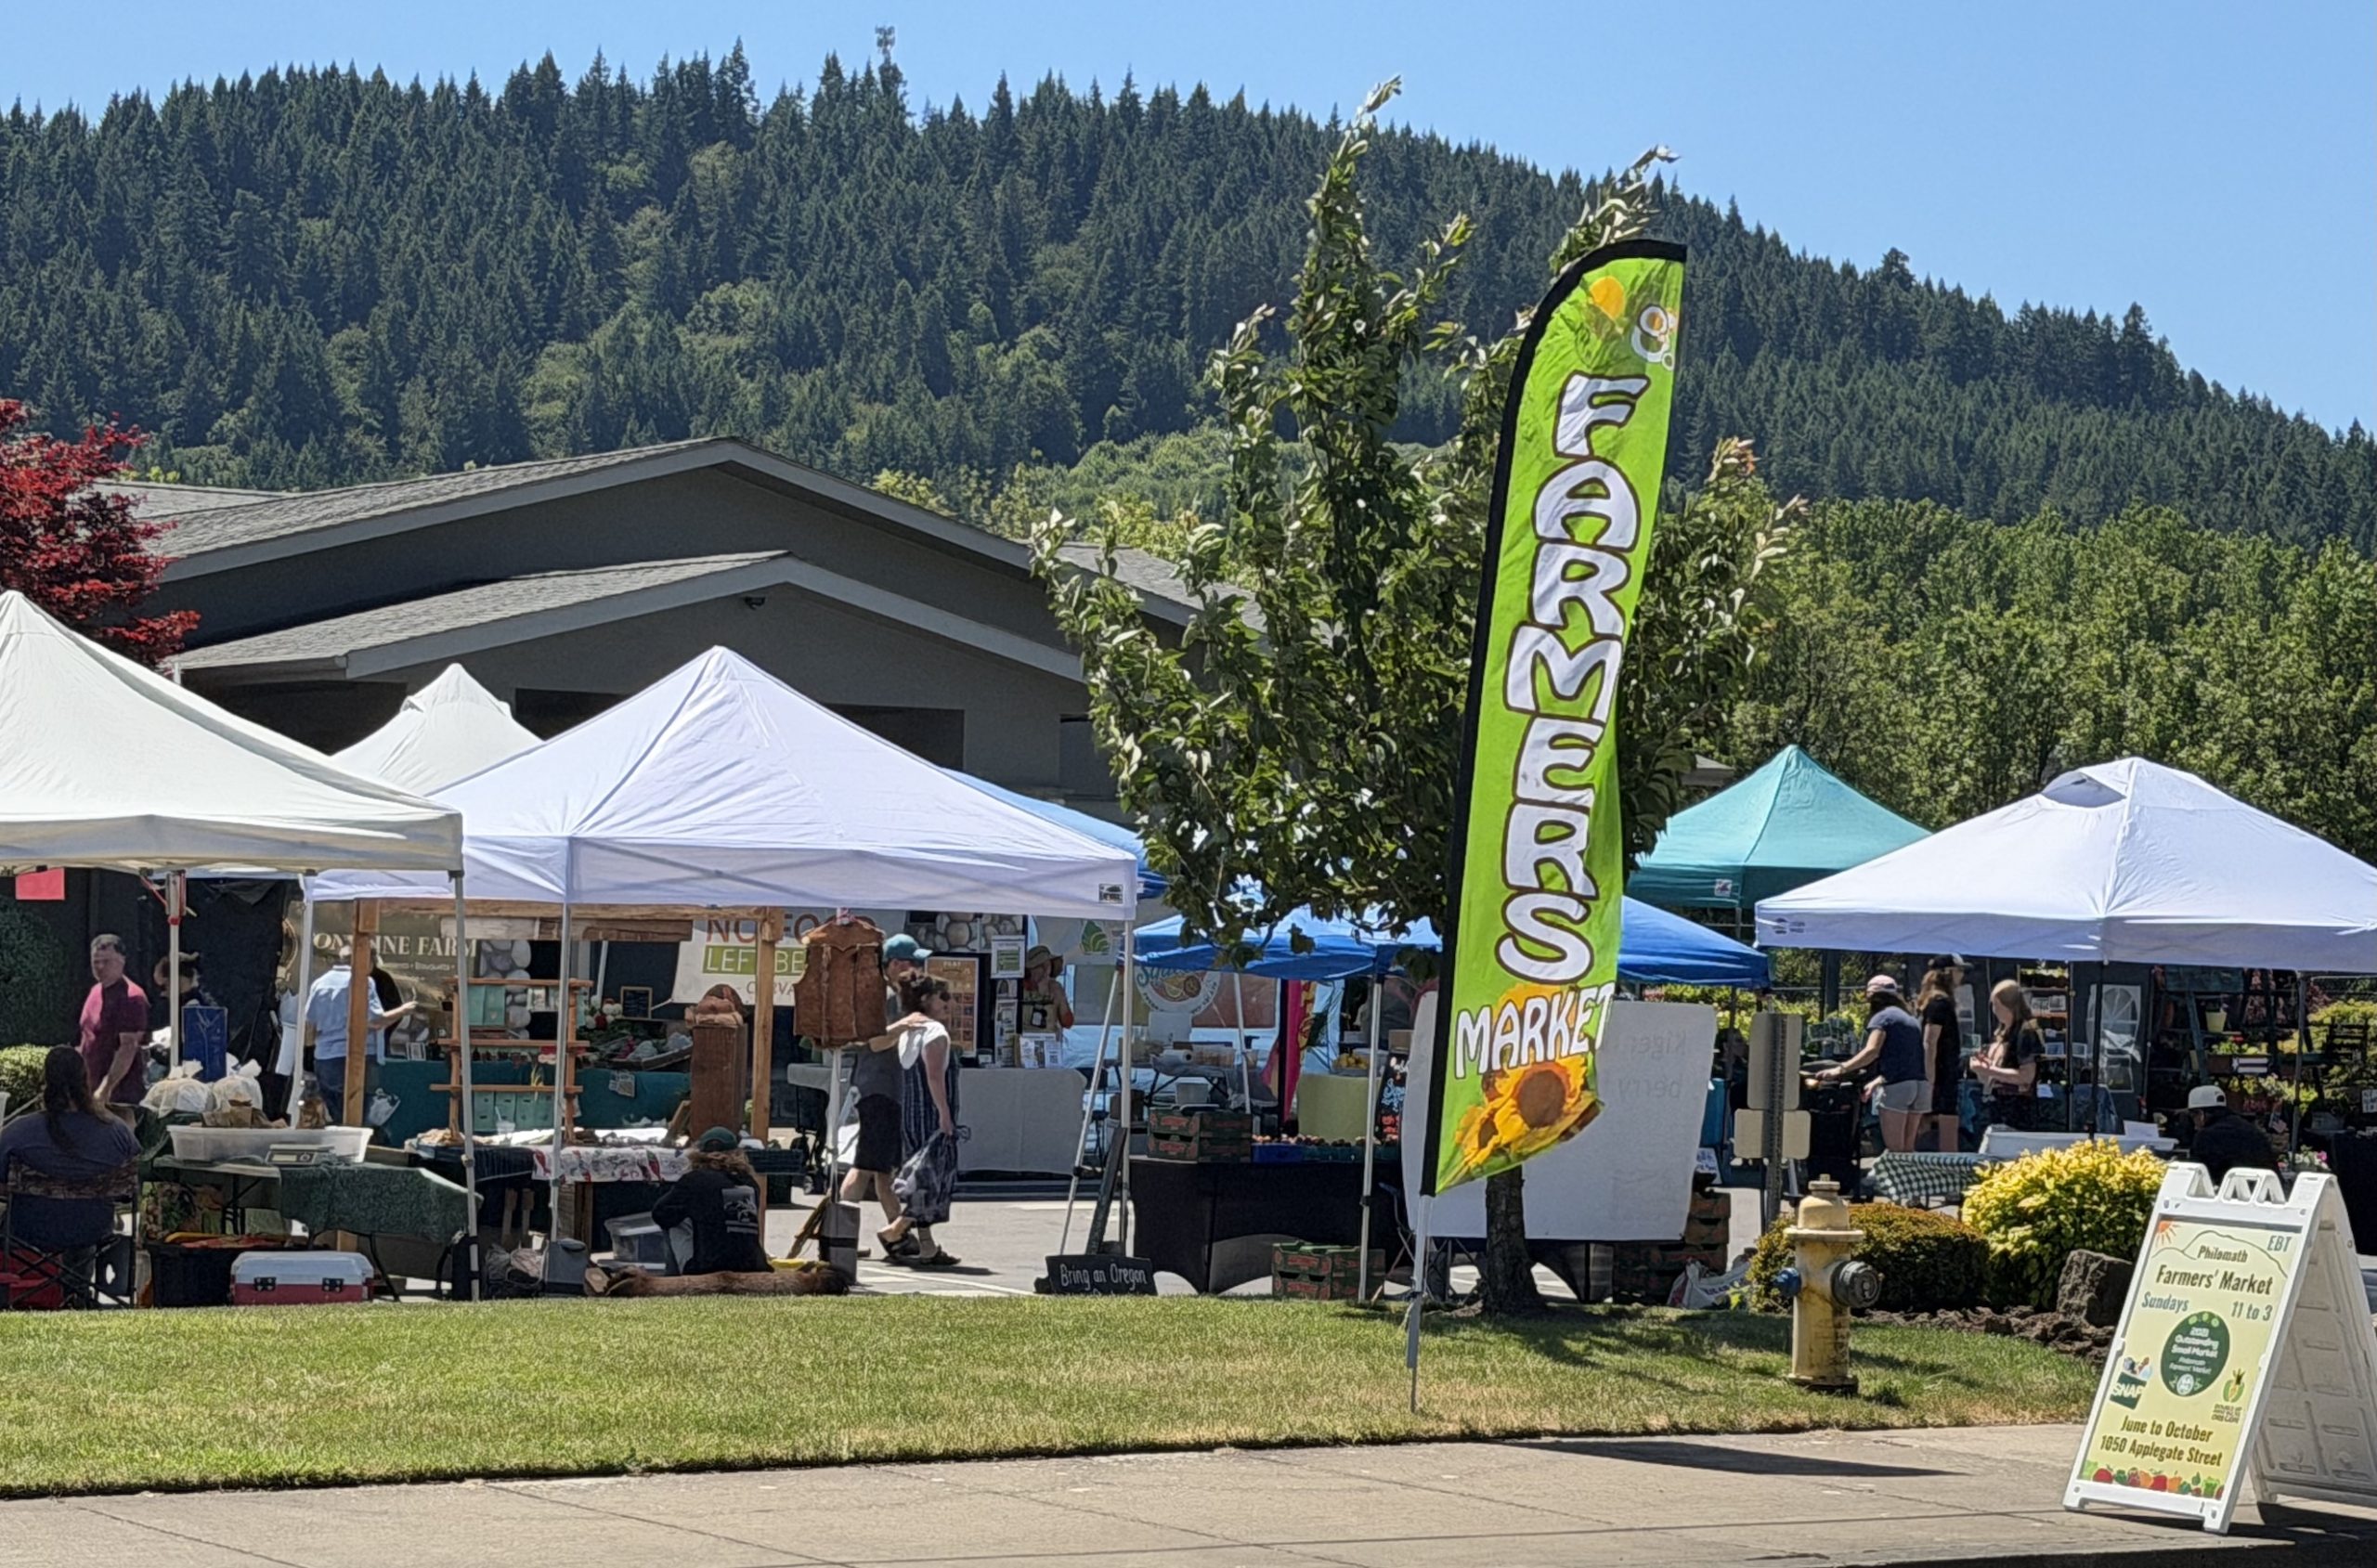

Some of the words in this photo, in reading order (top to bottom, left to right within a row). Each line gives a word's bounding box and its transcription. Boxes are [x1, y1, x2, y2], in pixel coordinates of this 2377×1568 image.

[1495, 373, 1650, 984] FARMERS
[706, 949, 757, 972] LEF
[1454, 980, 1617, 1081] MARKET
[2197, 1245, 2249, 1263] Philomath
[2267, 1235, 2293, 1252] EBT
[1059, 1263, 1091, 1291] Bring
[1093, 1269, 1107, 1283] an
[1110, 1263, 1148, 1291] Oregon
[2155, 1264, 2219, 1289] Farmers'
[2218, 1270, 2274, 1295] Market
[2141, 1291, 2189, 1314] Sundays
[2230, 1301, 2244, 1318] 11
[2246, 1302, 2260, 1320] to
[2262, 1304, 2273, 1322] 3
[2120, 1415, 2148, 1434] June
[2150, 1419, 2163, 1436] to
[2164, 1420, 2214, 1443] October
[2099, 1434, 2128, 1453] 1050
[2128, 1439, 2185, 1462] Applegate
[2187, 1446, 2223, 1467] Street
